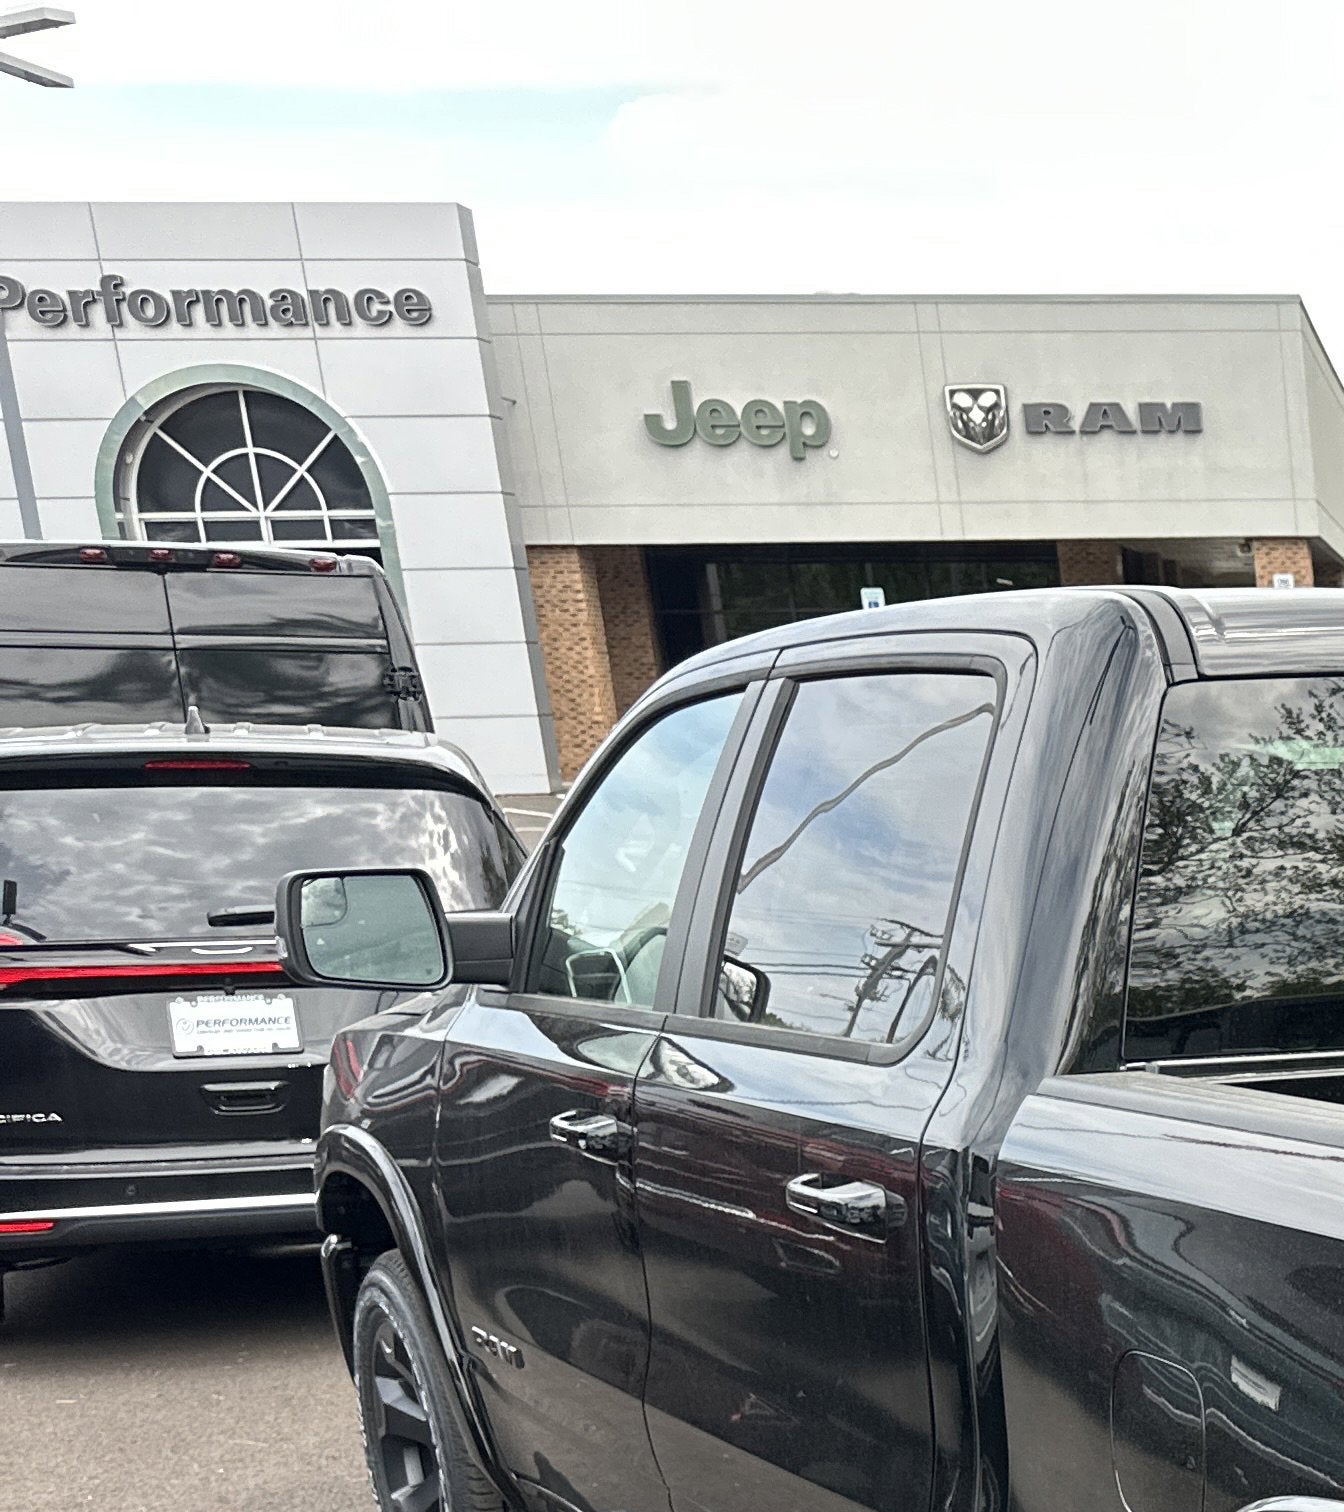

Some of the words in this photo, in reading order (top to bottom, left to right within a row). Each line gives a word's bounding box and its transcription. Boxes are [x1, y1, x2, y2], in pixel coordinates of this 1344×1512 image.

[0, 273, 432, 328] Performance
[644, 380, 832, 460] Jeep
[1023, 402, 1203, 434] RAM
[196, 1016, 291, 1029] PERFORMANCE
